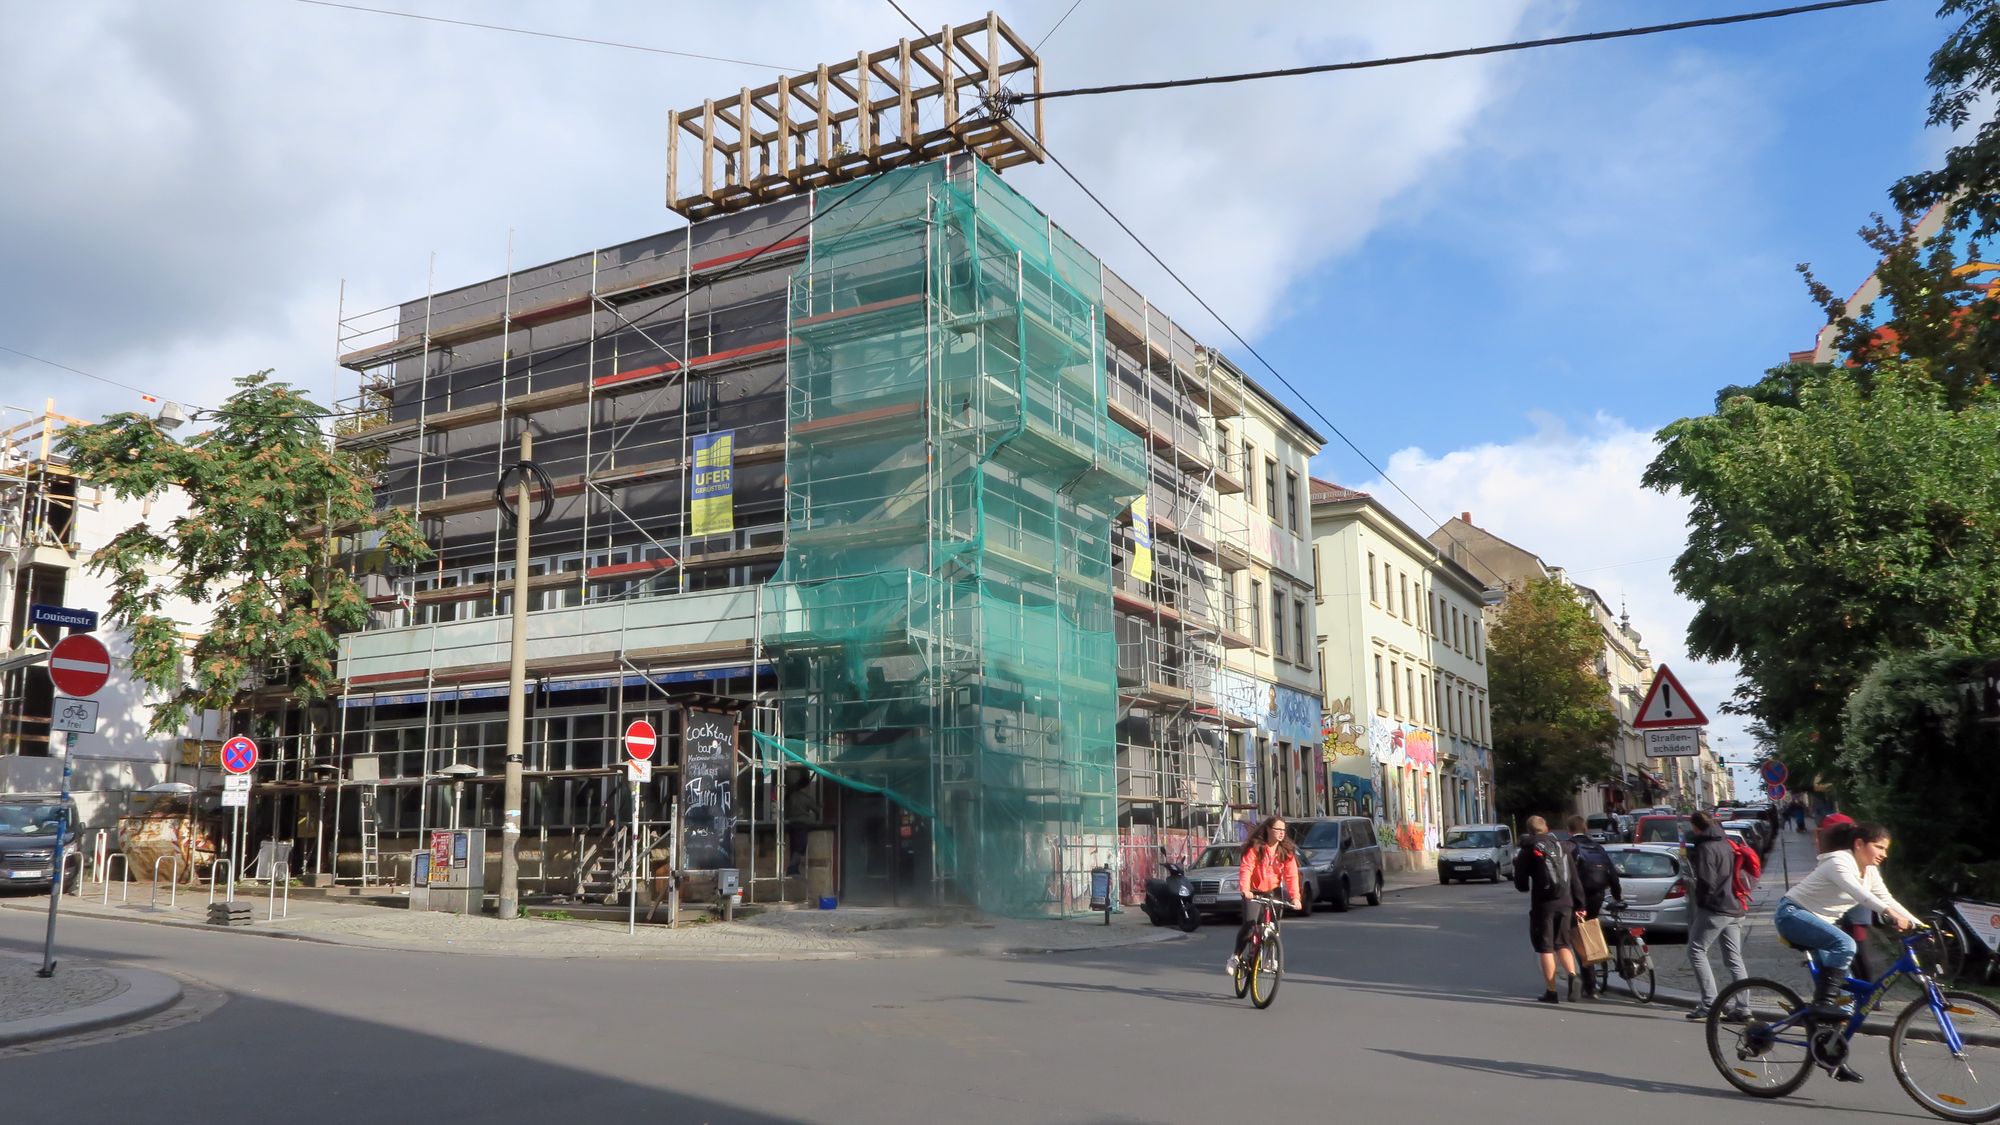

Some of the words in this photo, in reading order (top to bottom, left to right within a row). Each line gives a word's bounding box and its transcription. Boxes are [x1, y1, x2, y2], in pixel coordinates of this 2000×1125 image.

[696, 469, 730, 486] UFER
[35, 609, 92, 626] Louisenstr.
[67, 718, 82, 729] frei
[1651, 733, 1691, 743] Straßen-
[697, 741, 712, 754] bar
[1653, 743, 1692, 753] schäden
